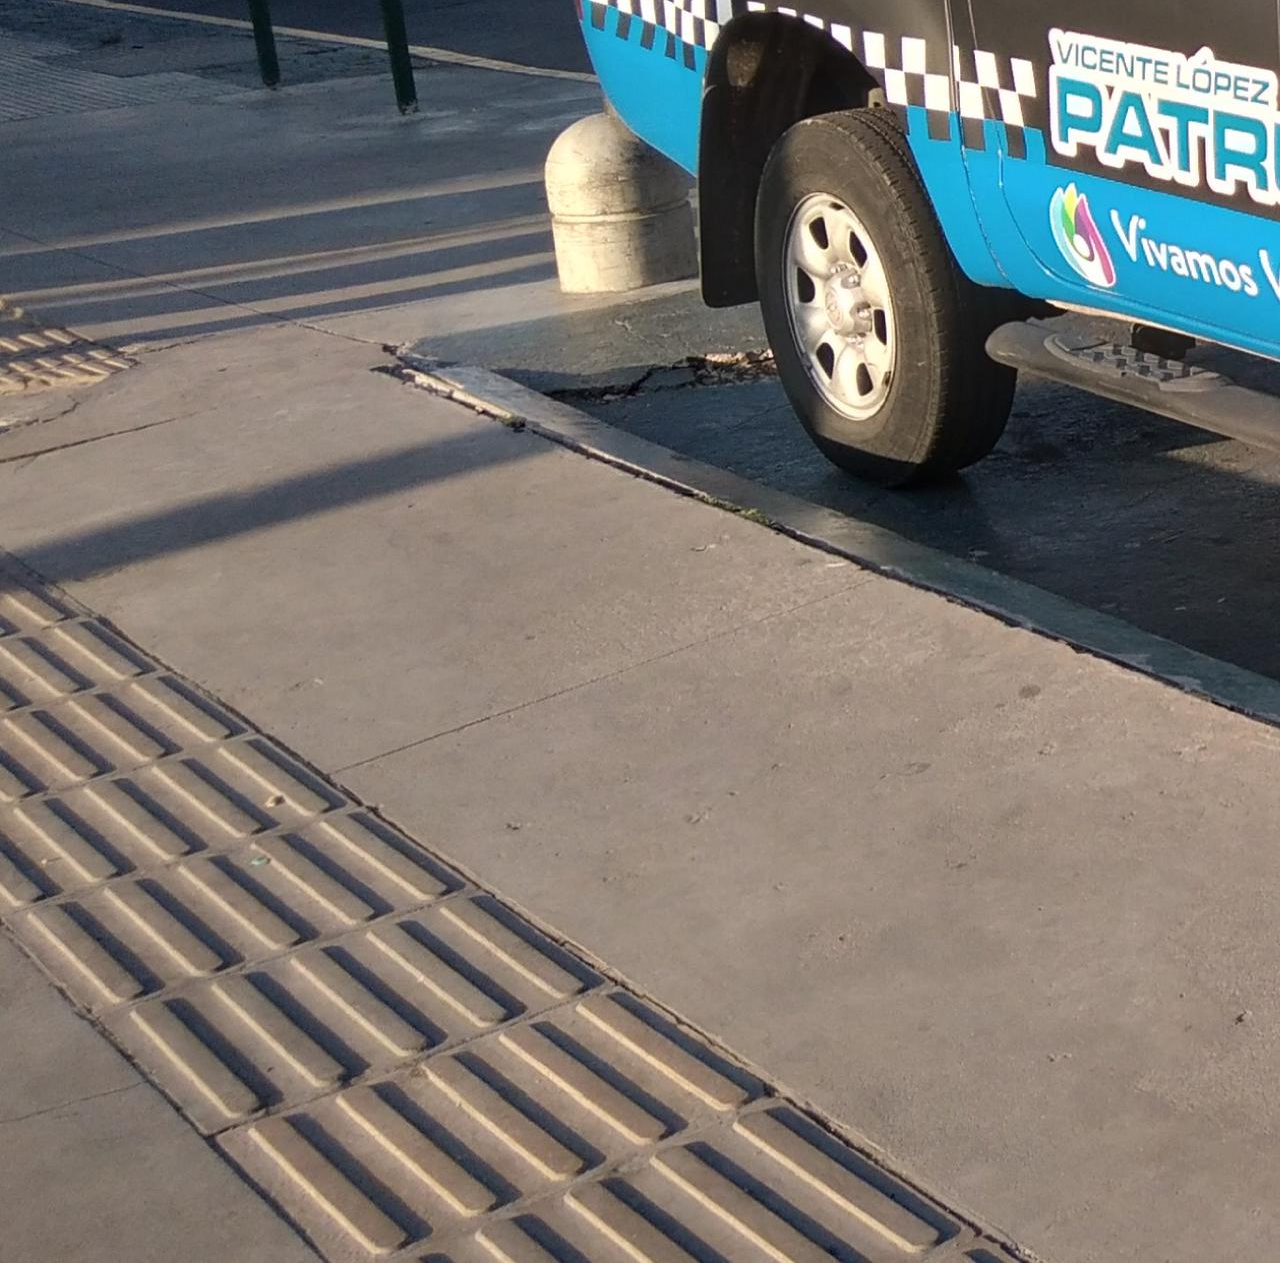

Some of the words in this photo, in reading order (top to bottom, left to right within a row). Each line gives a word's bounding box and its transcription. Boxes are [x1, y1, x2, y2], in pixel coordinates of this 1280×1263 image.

[1055, 39, 1170, 85] VICENTE
[1175, 58, 1271, 106] LÓPEZ
[1110, 207, 1260, 299] Vivamos
